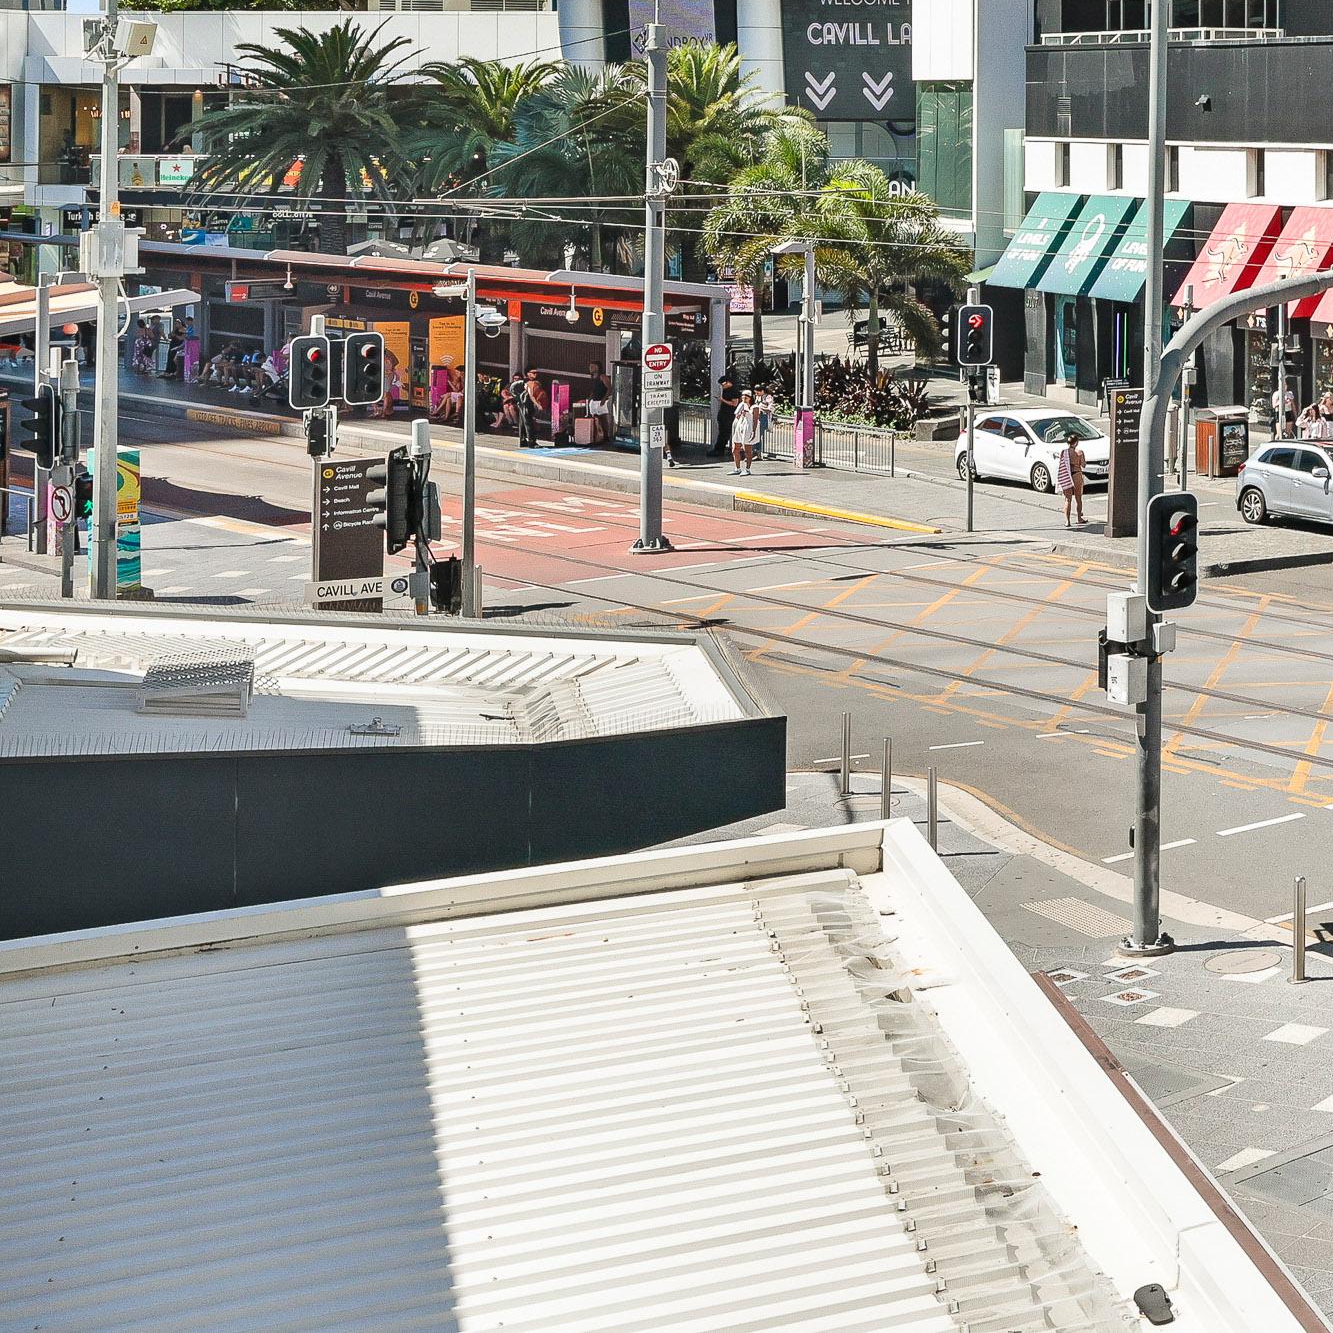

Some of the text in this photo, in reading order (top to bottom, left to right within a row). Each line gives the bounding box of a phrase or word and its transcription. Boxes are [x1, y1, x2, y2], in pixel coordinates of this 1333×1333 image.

[807, 21, 913, 46] CAVILL LA
[1016, 233, 1051, 246] LEVELS
[1121, 241, 1148, 255] LEVE
[1007, 249, 1043, 262] OF FUN
[553, 308, 567, 317] Avenu
[648, 360, 667, 368] ENTRY
[646, 379, 670, 387] TRAMWAY
[335, 465, 356, 474] Cavill
[335, 472, 363, 480] Avenue
[317, 581, 383, 598] CAVILL AVE
